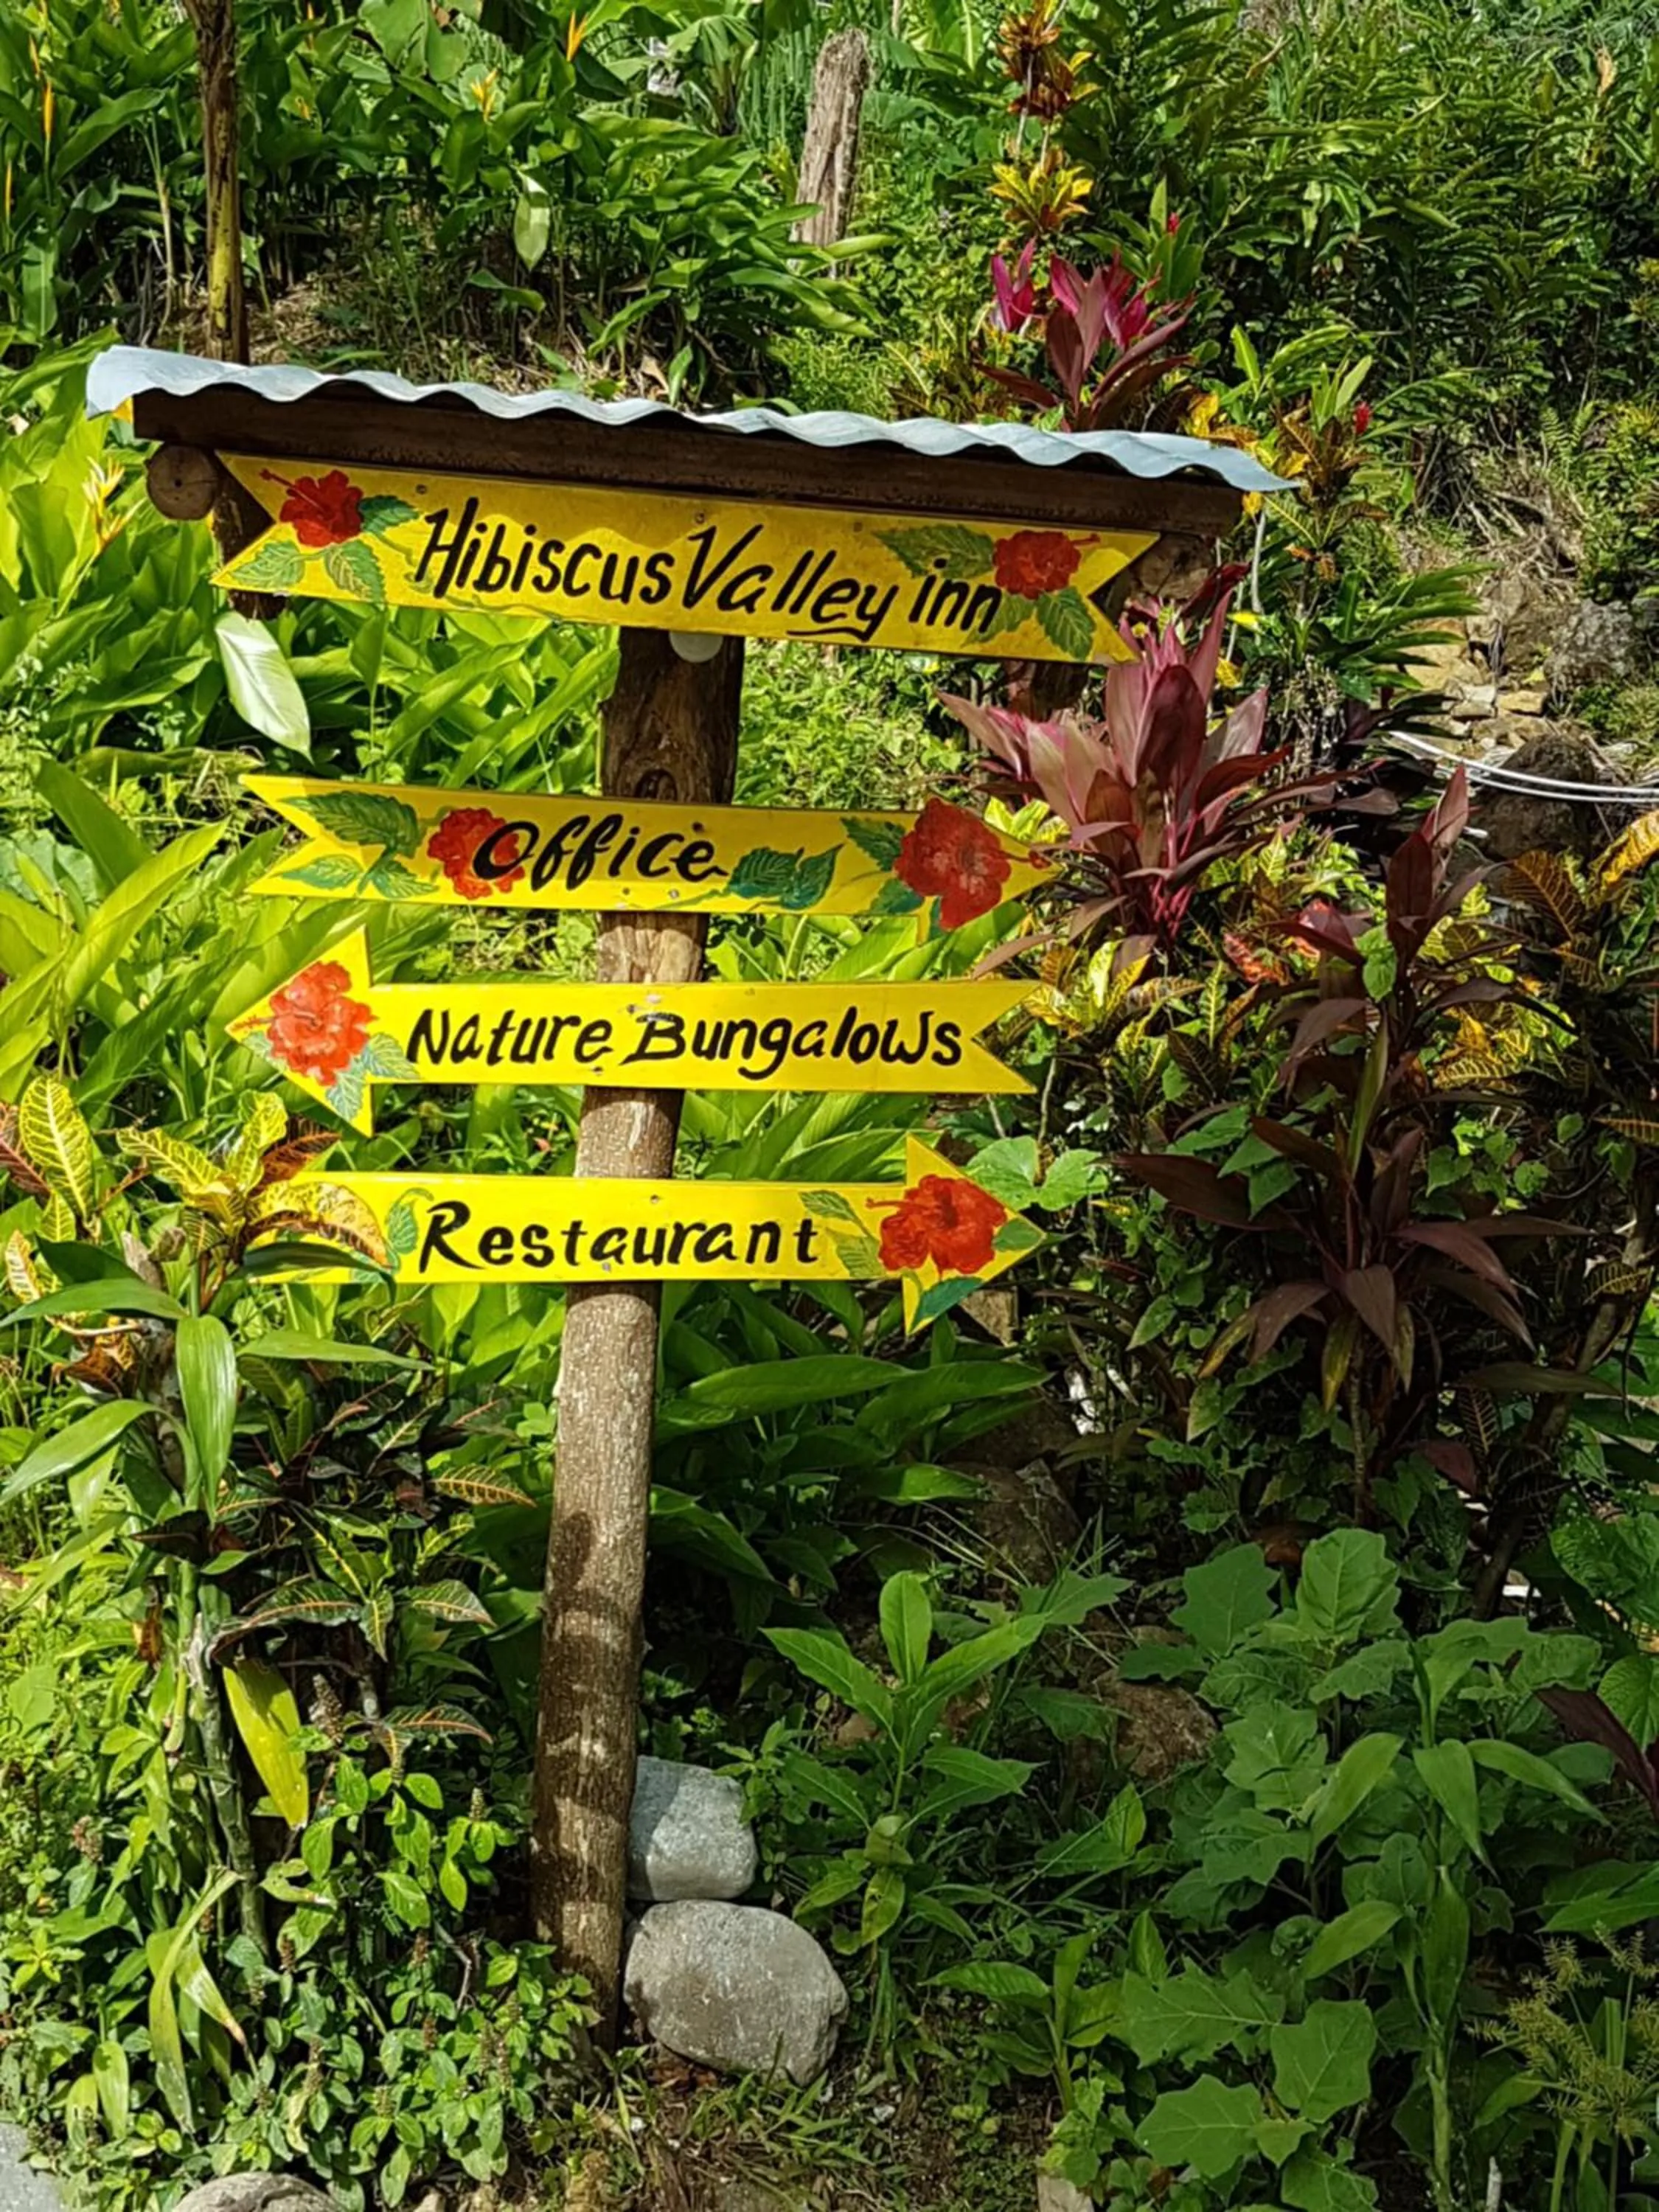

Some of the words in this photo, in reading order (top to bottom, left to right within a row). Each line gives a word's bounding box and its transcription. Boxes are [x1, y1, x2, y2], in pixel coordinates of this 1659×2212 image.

[414, 497, 675, 605] Hibiscus
[682, 524, 900, 641] Valley
[908, 557, 1002, 633] inn
[473, 814, 728, 891] Office
[407, 1009, 613, 1064] Nature
[619, 1006, 963, 1080] Bungalows
[418, 1200, 819, 1274] Restaurant
